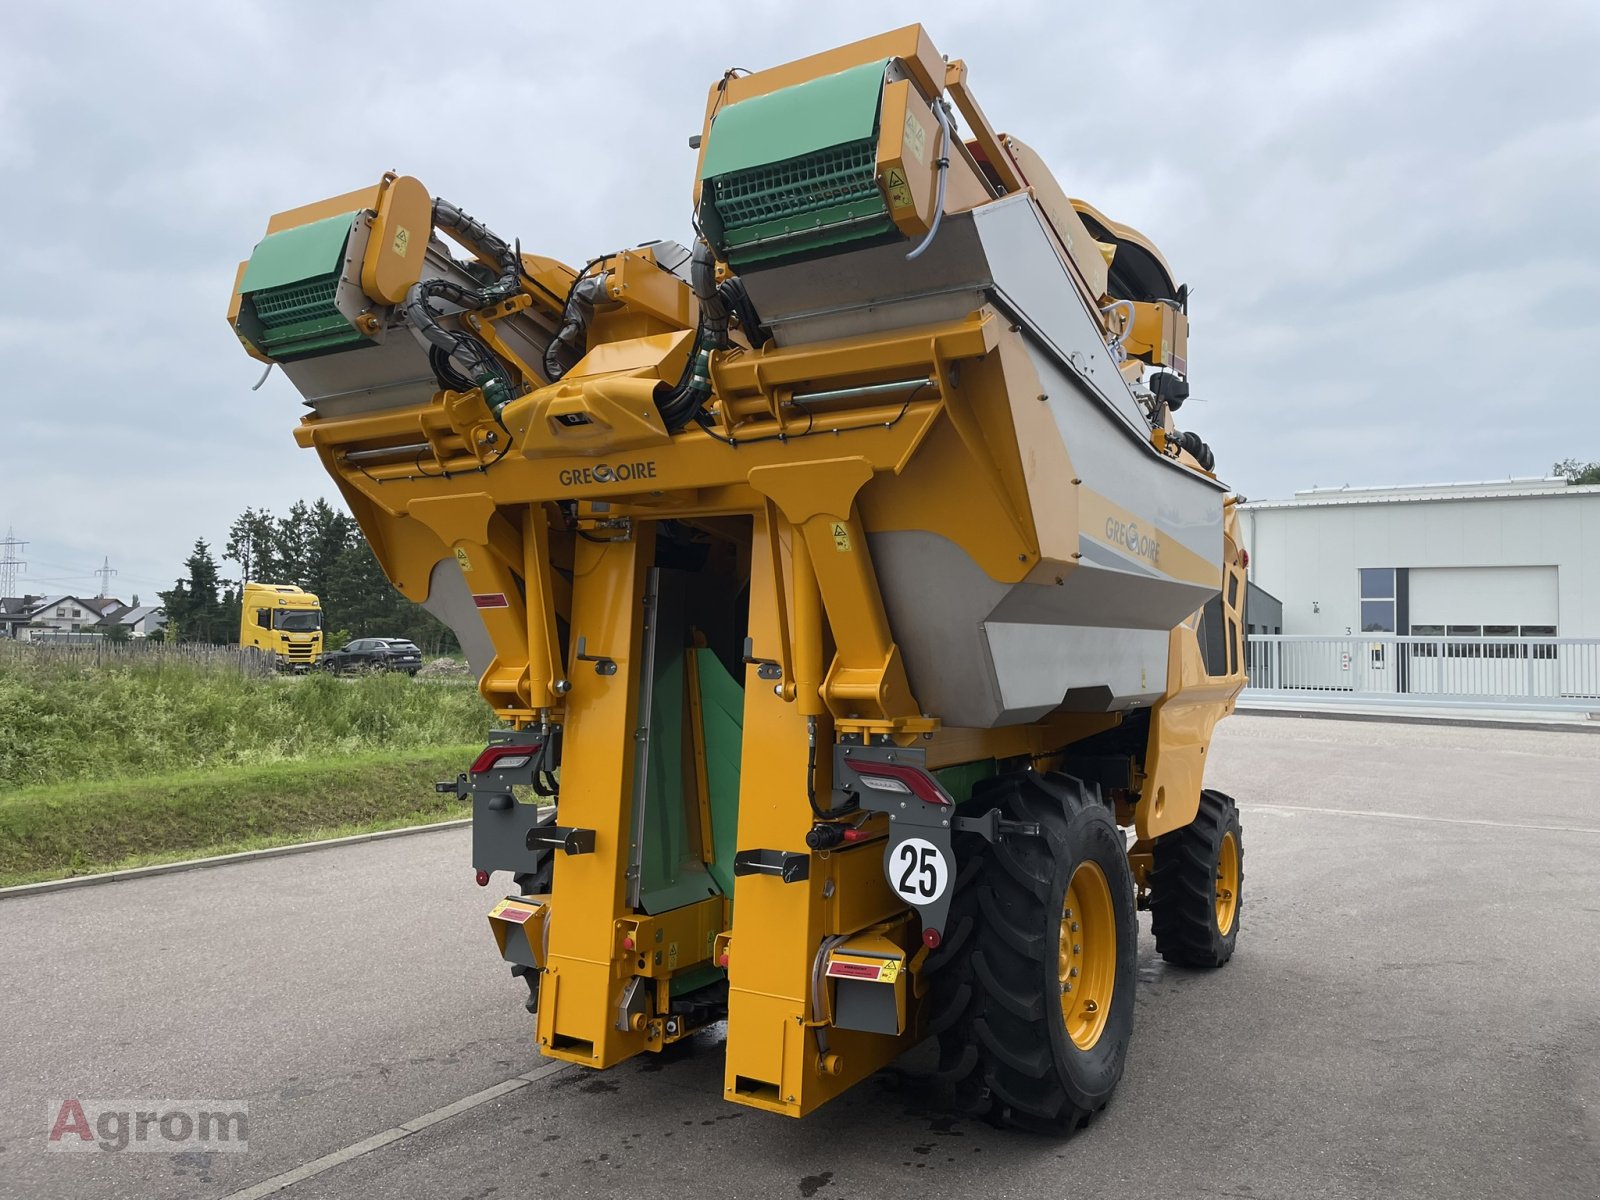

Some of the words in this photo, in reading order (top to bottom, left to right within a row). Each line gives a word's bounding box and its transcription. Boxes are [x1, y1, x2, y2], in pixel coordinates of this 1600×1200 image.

[559, 462, 656, 486] GREGOIRE
[1106, 516, 1160, 563] GREGOIRE
[899, 845, 937, 898] 25
